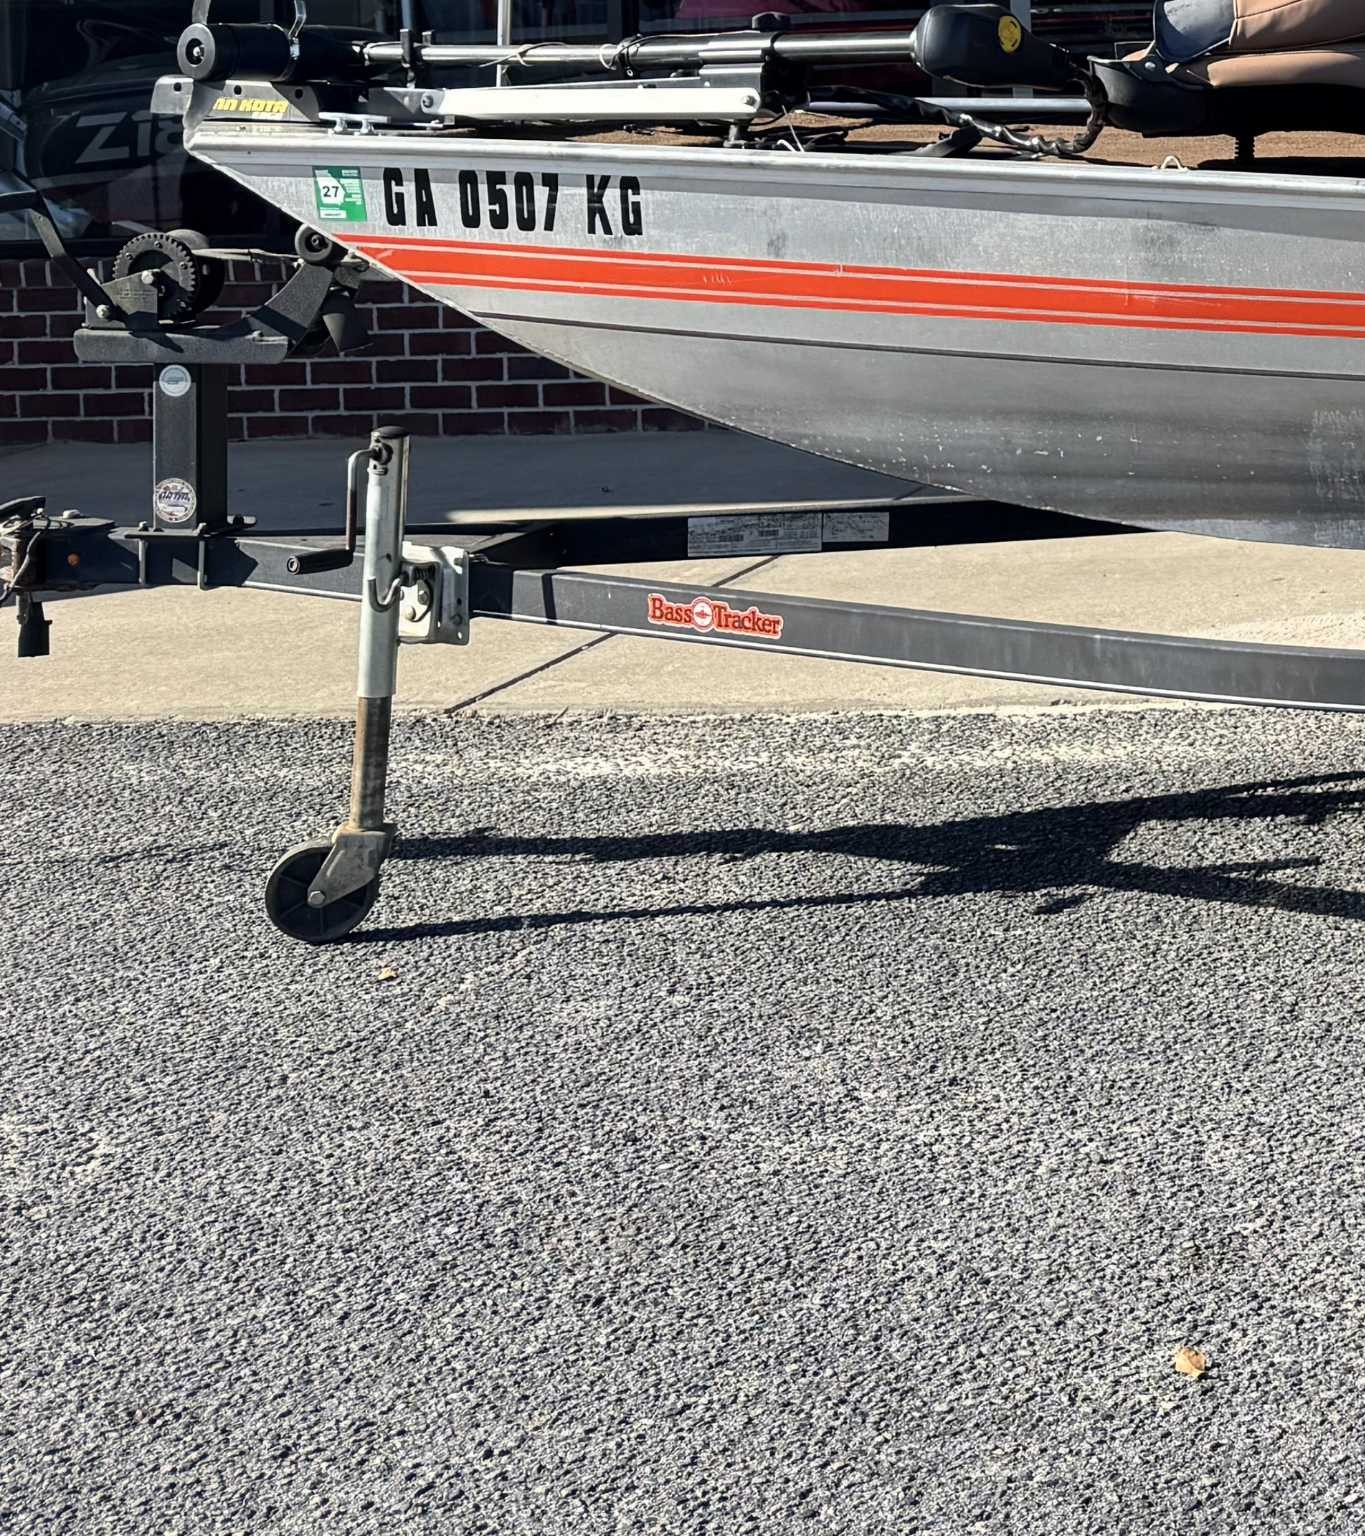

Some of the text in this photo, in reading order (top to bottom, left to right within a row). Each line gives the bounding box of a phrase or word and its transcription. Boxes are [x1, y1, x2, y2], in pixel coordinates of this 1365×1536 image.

[322, 185, 340, 198] 27
[382, 166, 437, 228] GA
[458, 169, 559, 233] 0507
[585, 174, 644, 237] KG
[651, 597, 781, 635] Bass Tracker
